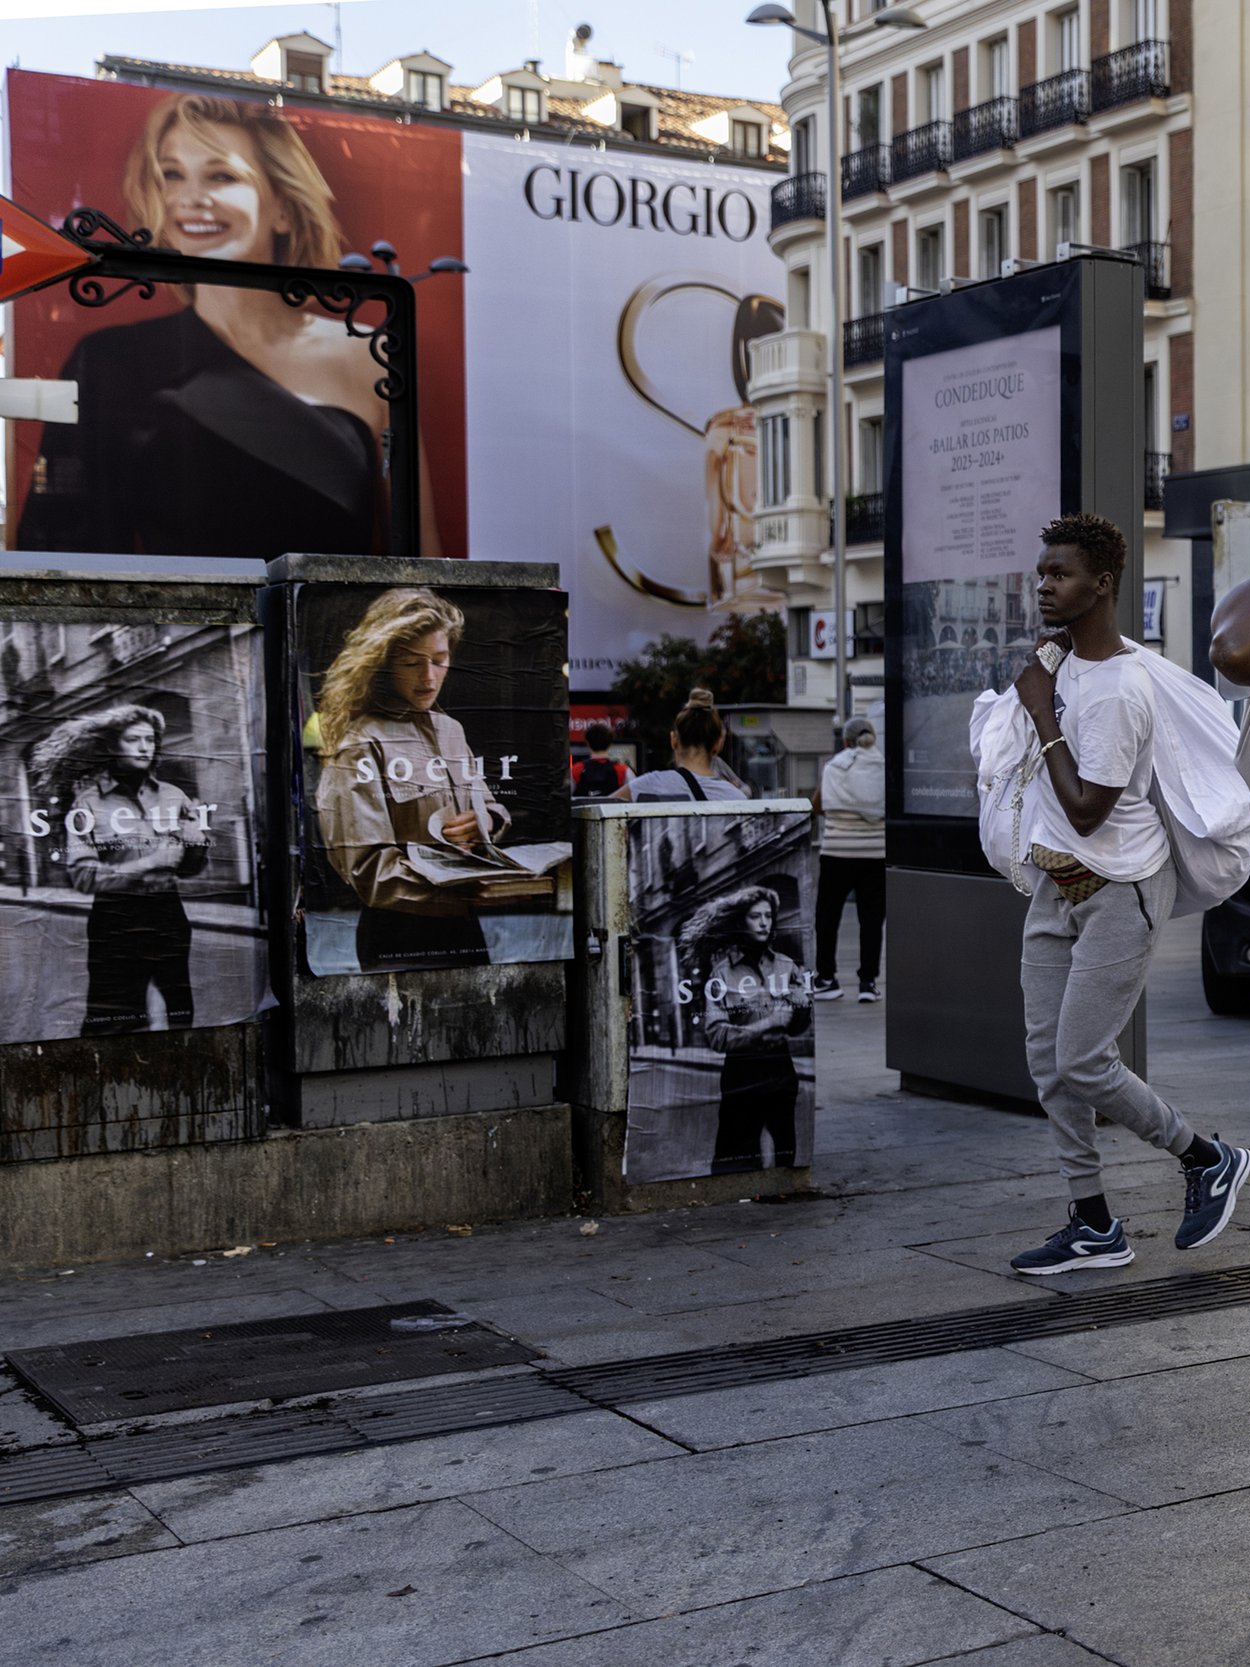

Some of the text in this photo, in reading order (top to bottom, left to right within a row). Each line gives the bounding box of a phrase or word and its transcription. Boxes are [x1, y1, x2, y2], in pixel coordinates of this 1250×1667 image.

[523, 163, 758, 243] GIORGIO
[934, 373, 1025, 409] CONDEDUQUE
[971, 428, 990, 448] LOS
[993, 422, 1030, 446] PATIOS
[355, 754, 519, 784] soeur
[28, 802, 218, 838] soeur
[677, 970, 815, 1005] soeur
